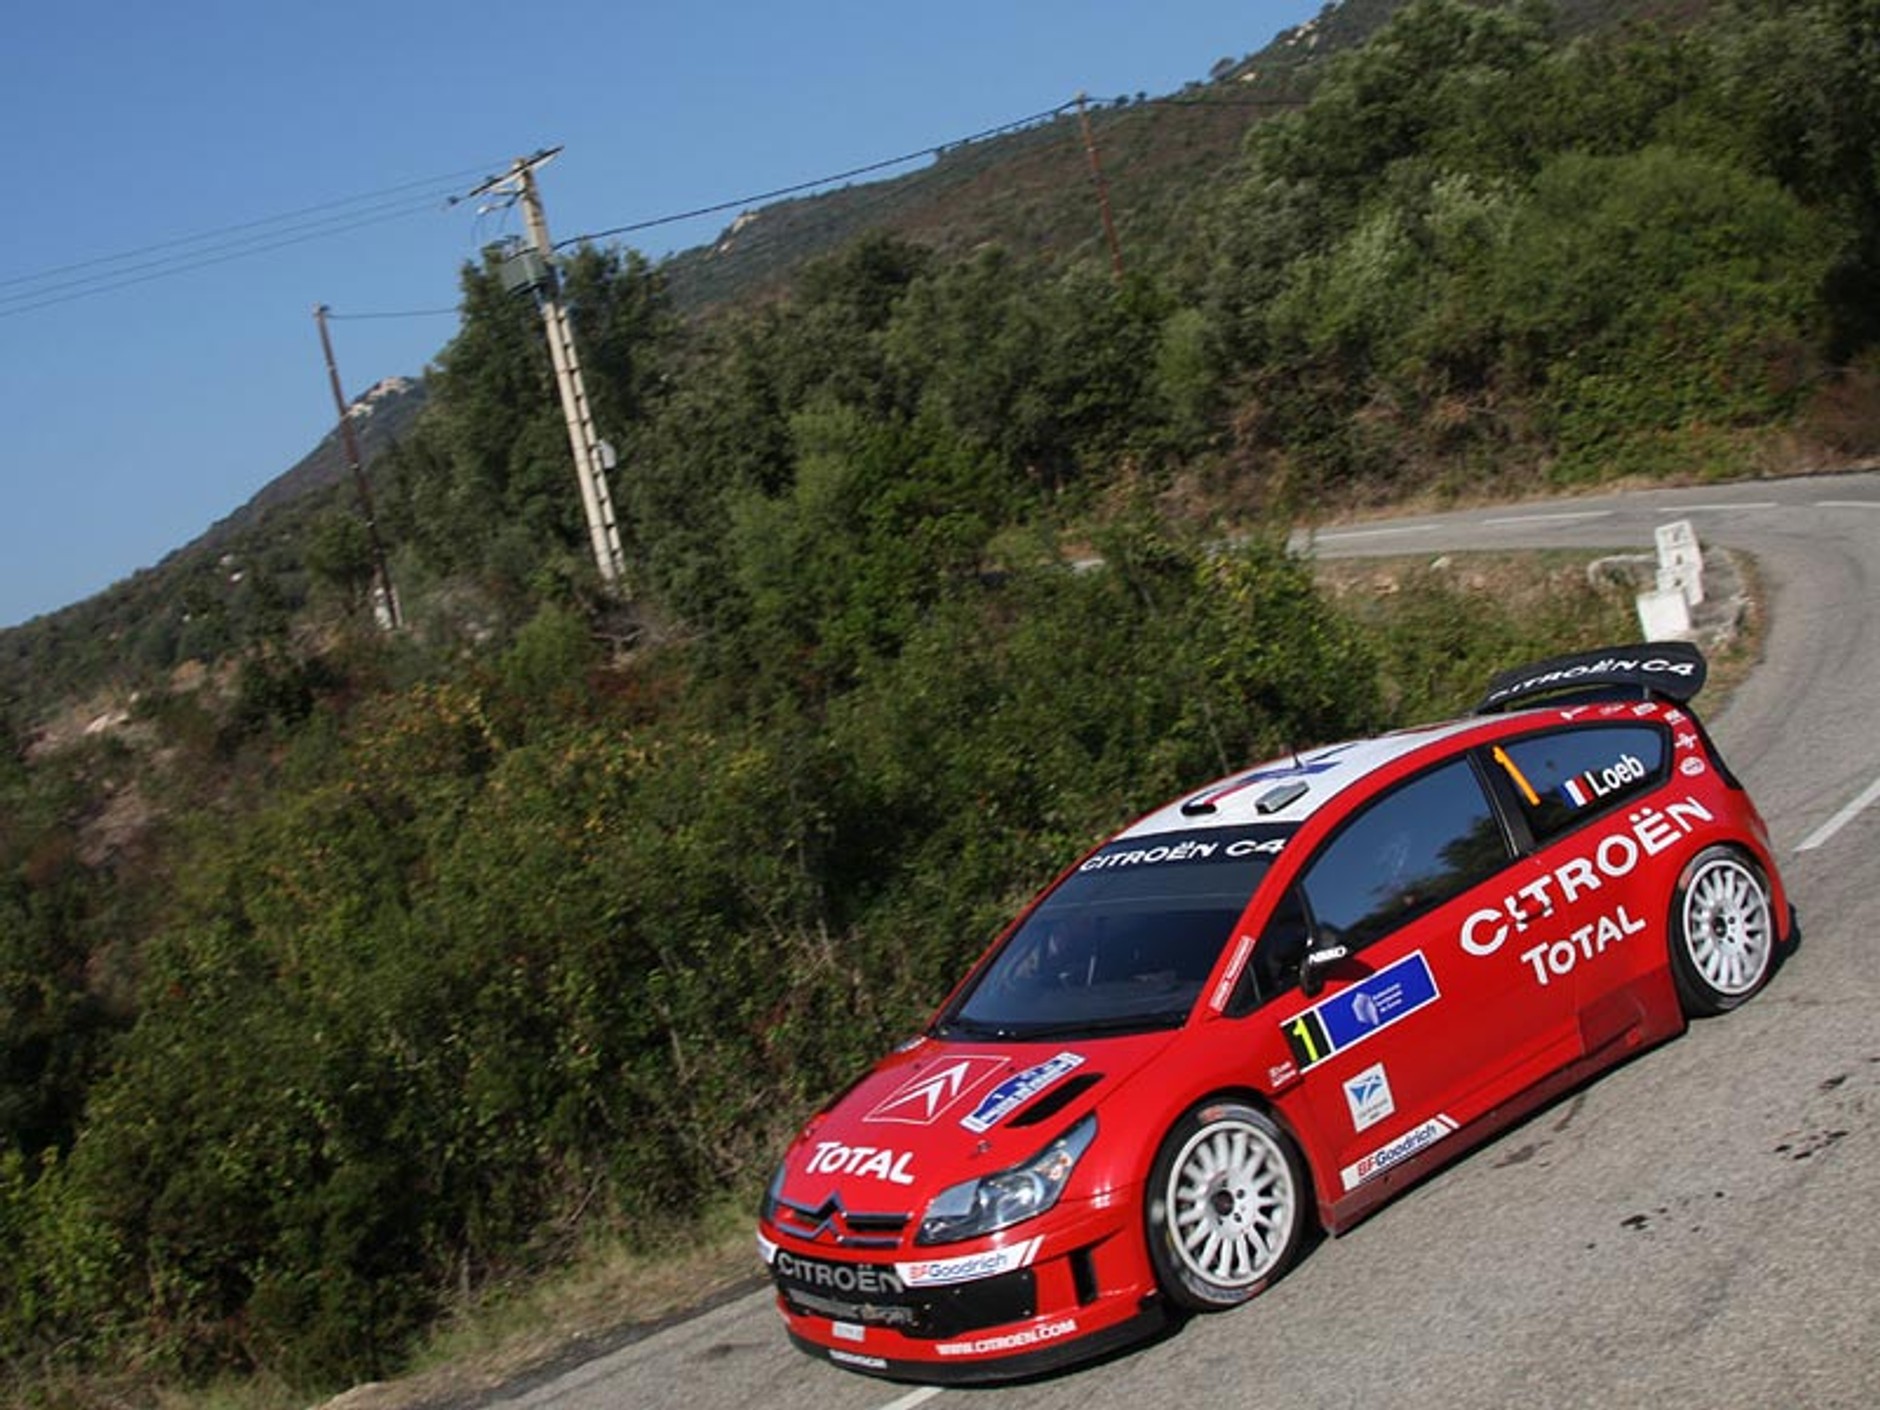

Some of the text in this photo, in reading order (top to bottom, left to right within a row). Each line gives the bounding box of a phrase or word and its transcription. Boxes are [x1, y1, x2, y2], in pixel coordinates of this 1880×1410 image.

[1492, 746, 1541, 806] 1
[1585, 754, 1646, 796] Loeb
[1079, 838, 1288, 872] CITROËN C4
[1460, 796, 1714, 957] CITROËN
[1520, 905, 1647, 986] TOTAL
[1292, 1016, 1319, 1064] 1
[805, 1141, 915, 1186] TOTAL
[1356, 1123, 1437, 1179] BFGoodrich
[776, 1249, 905, 1294] CITROËN
[907, 1251, 1010, 1281] BFGoodrich
